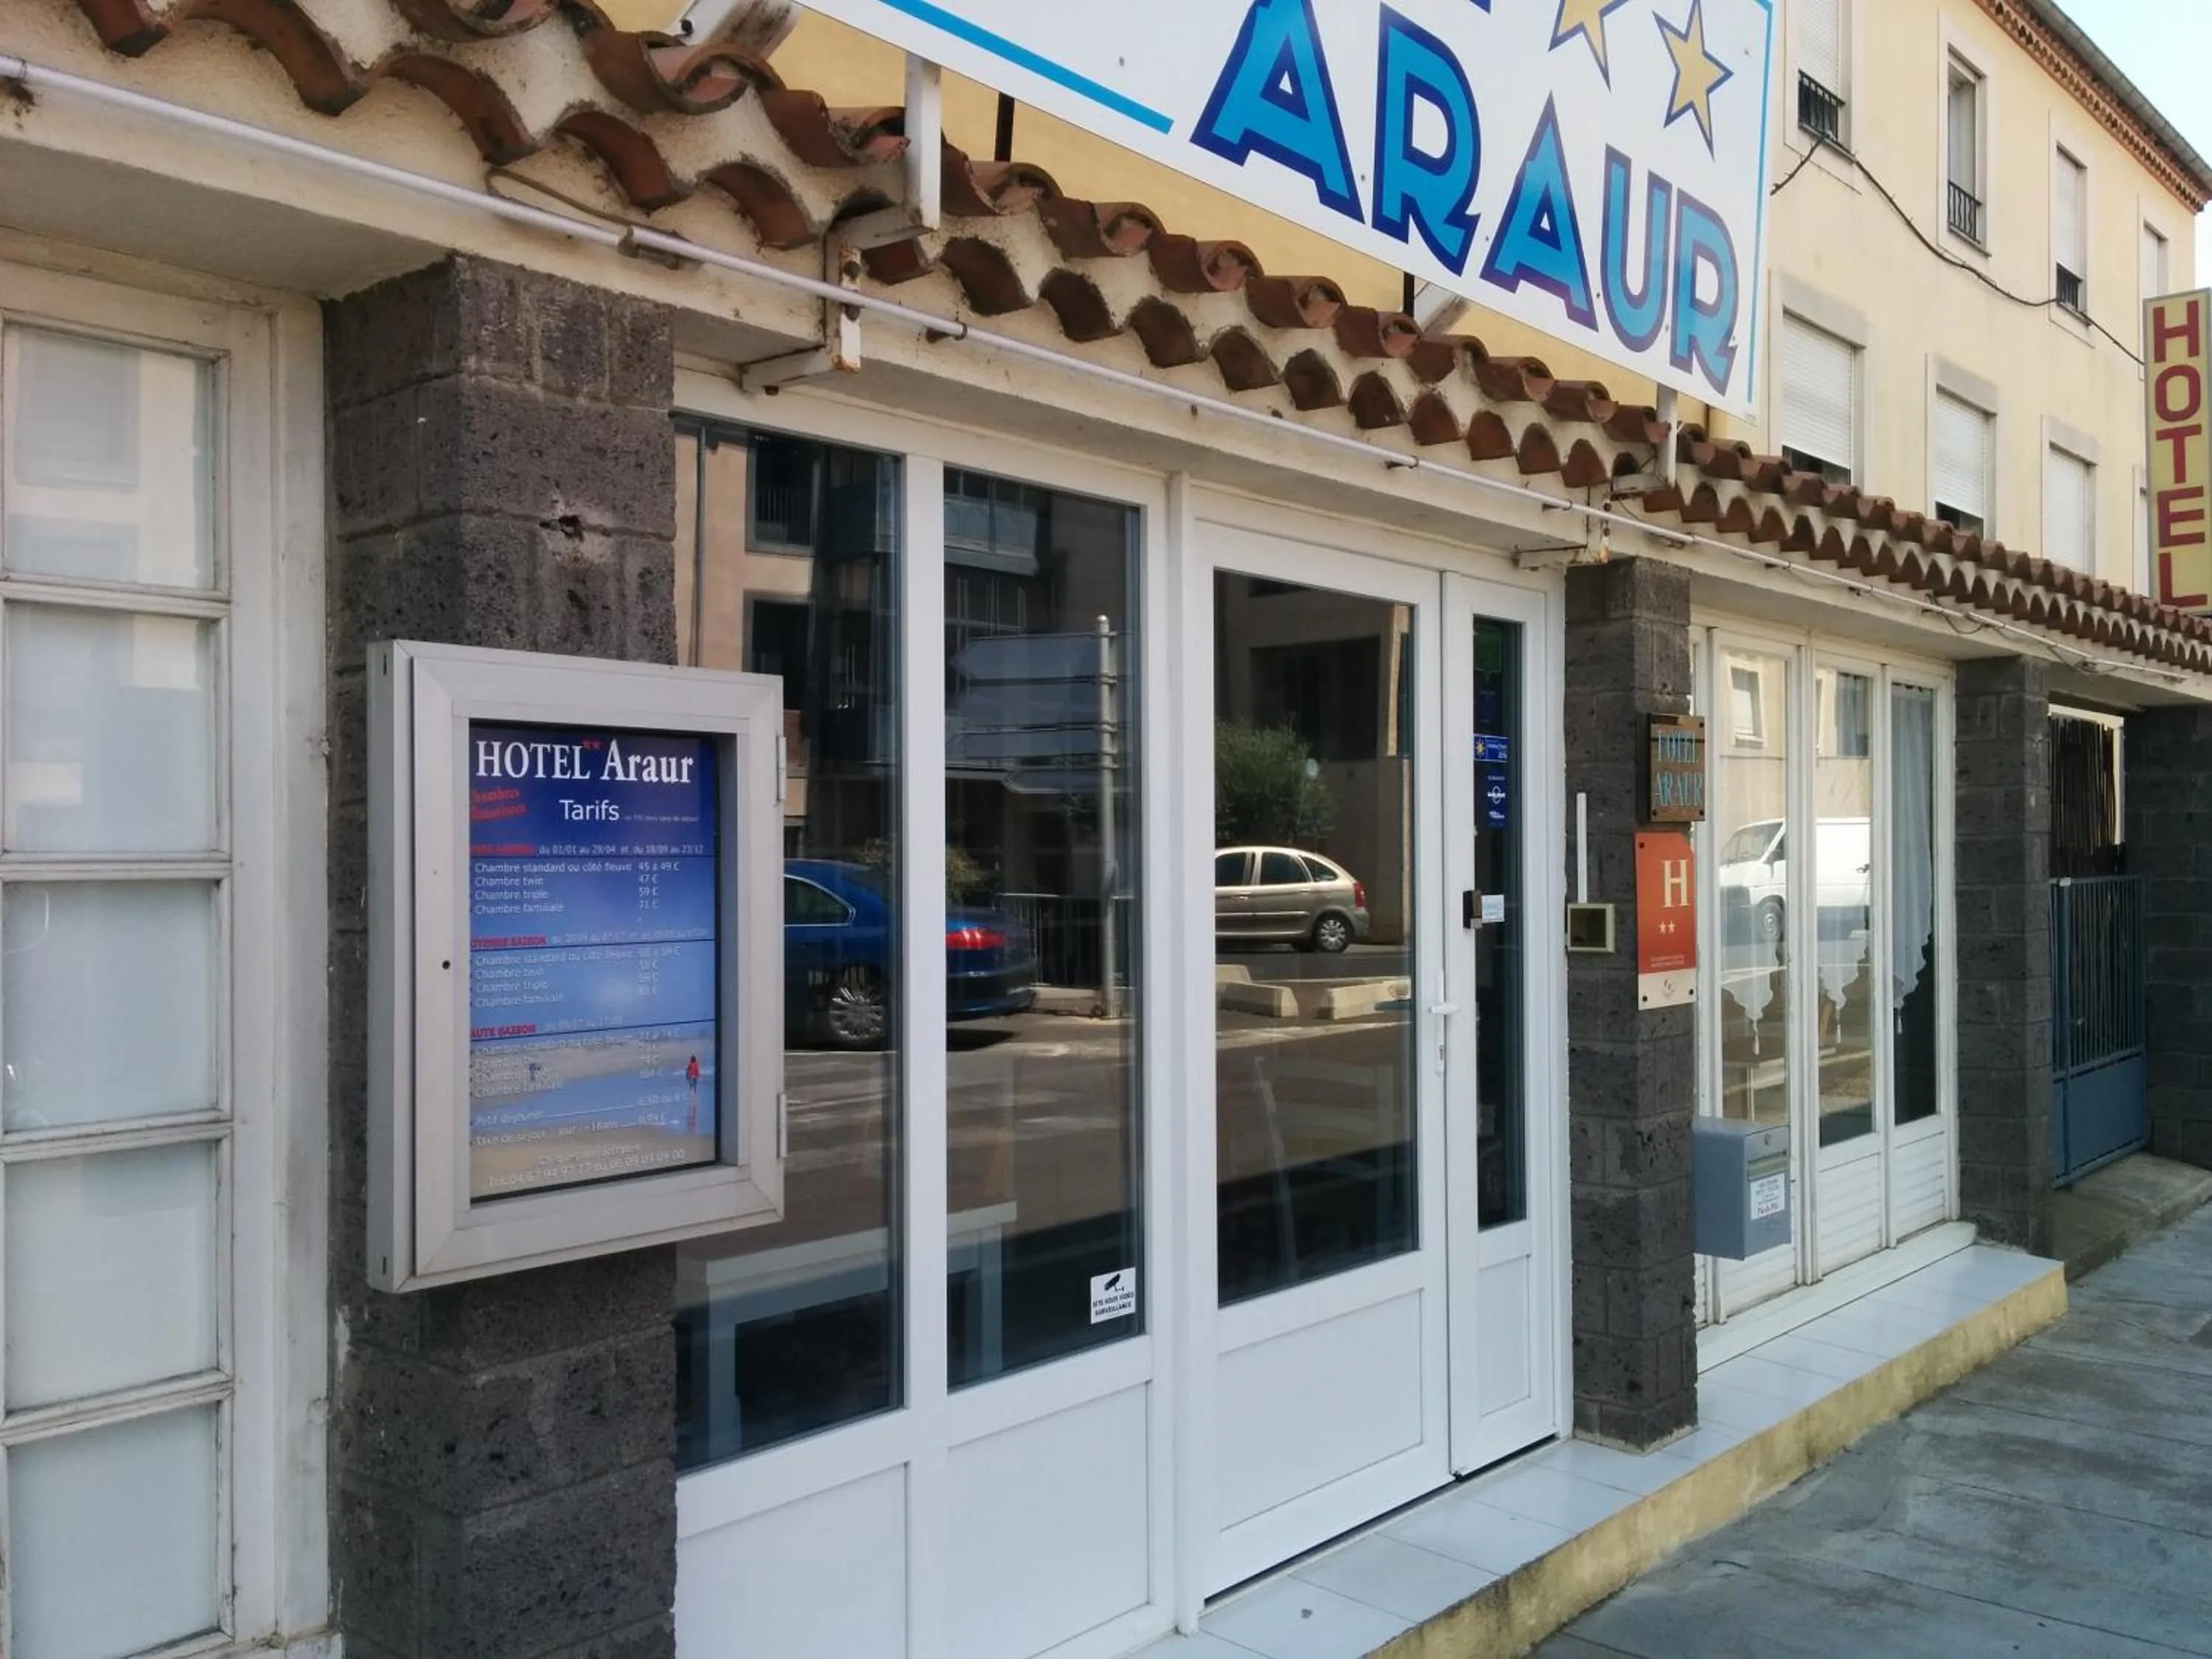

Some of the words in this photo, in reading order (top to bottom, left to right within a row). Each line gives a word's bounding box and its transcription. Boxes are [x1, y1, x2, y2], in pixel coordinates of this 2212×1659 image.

[1189, 0, 1739, 397] ARAUR
[2152, 299, 2208, 608] HOTEL
[476, 740, 590, 779] HOTEL
[601, 738, 694, 784] Araur
[559, 799, 620, 821] Tarifs
[475, 863, 520, 873] Chambre
[523, 861, 566, 872] standard
[475, 876, 520, 886] Chambre
[1662, 858, 1691, 908] H
[475, 890, 520, 900] Chambre
[476, 904, 520, 915] Chambre
